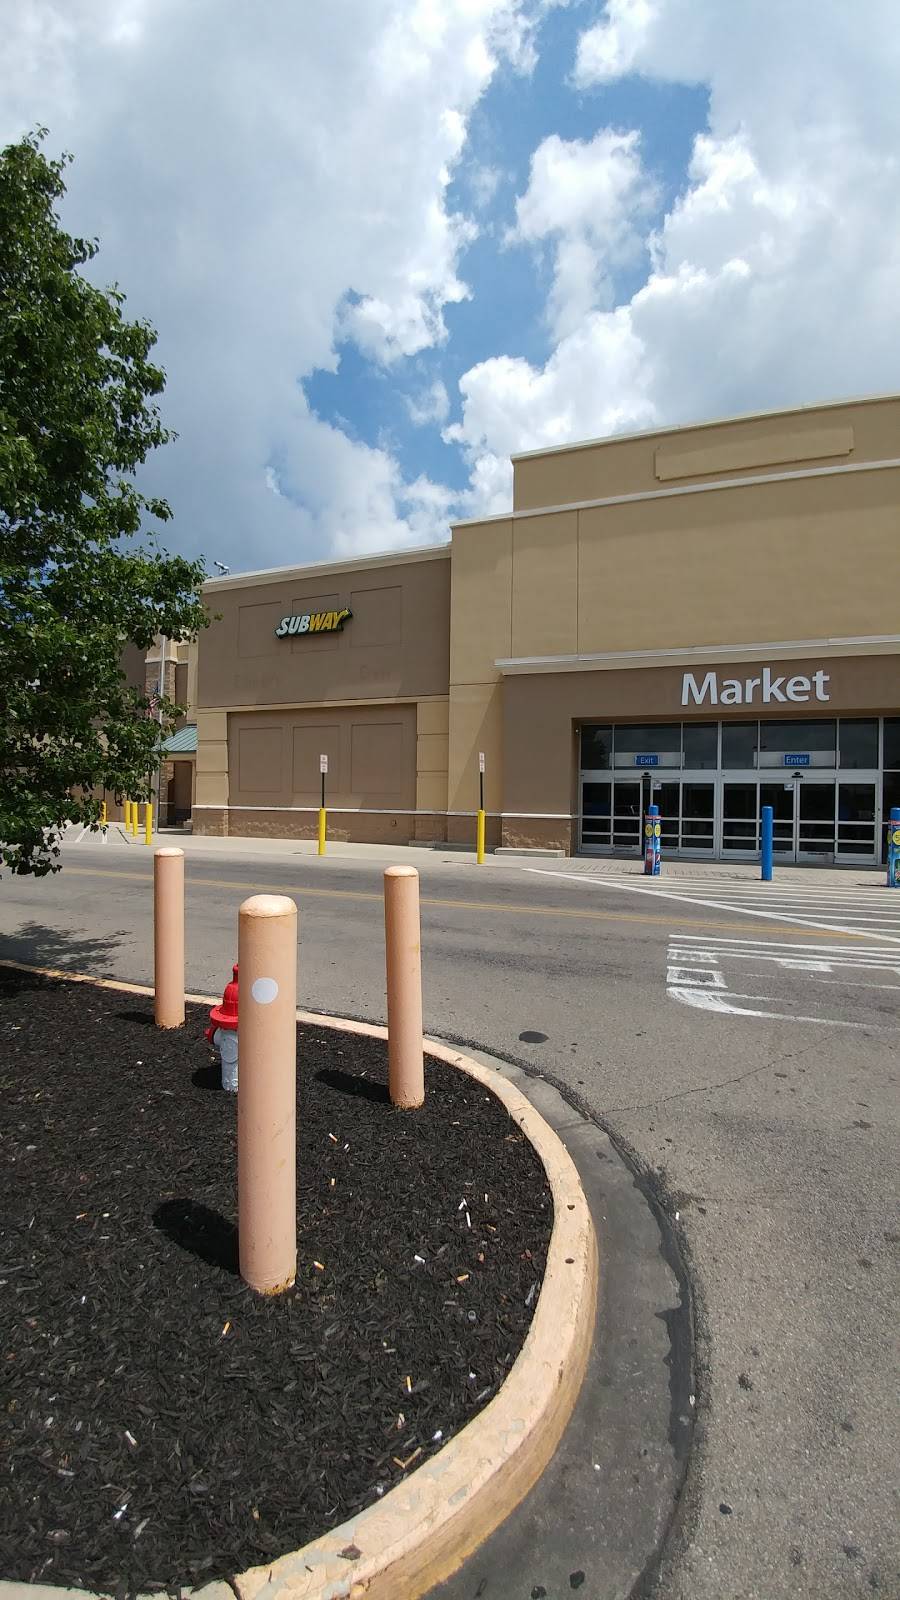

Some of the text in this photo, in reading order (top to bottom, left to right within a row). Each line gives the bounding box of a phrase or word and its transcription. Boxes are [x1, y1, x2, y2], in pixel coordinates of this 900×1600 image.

[275, 608, 351, 637] SUBWAY
[681, 667, 830, 706] Market
[640, 756, 654, 764] Exit
[786, 755, 808, 764] Enter
